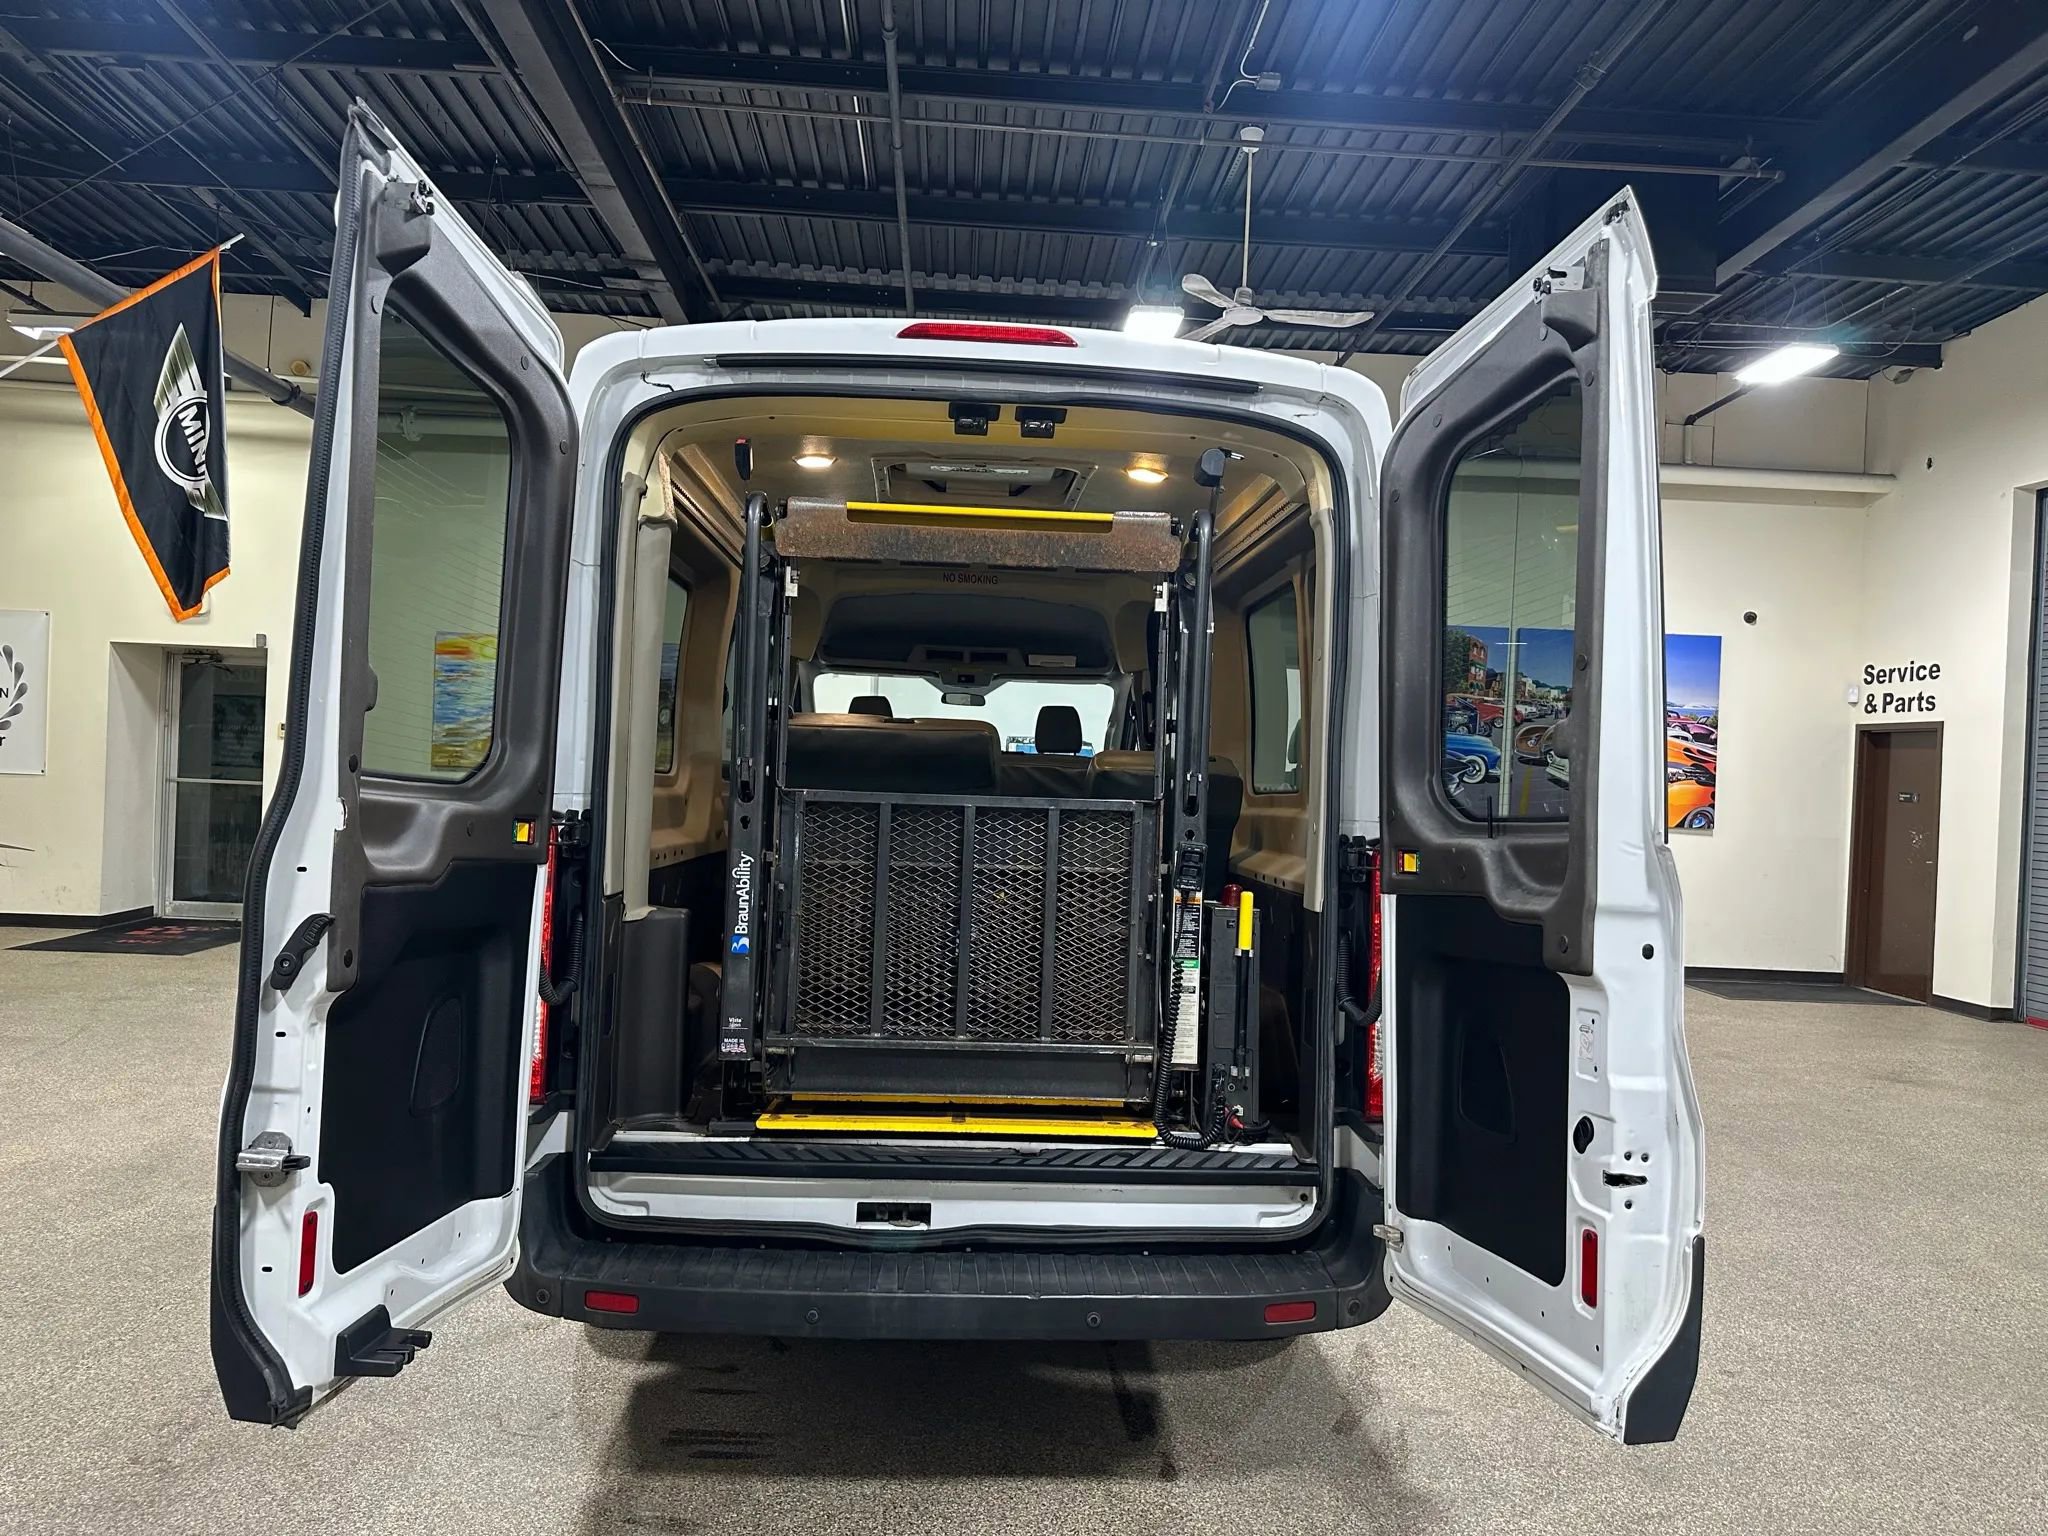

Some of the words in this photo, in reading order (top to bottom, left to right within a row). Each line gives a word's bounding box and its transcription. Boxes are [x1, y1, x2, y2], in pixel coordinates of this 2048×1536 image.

[943, 572, 956, 583] NO
[958, 573, 998, 585] SMOKING
[1863, 660, 1941, 686] Service
[1864, 693, 1878, 714] &
[1882, 691, 1936, 713] Parts
[731, 850, 755, 934] BraunAbility
